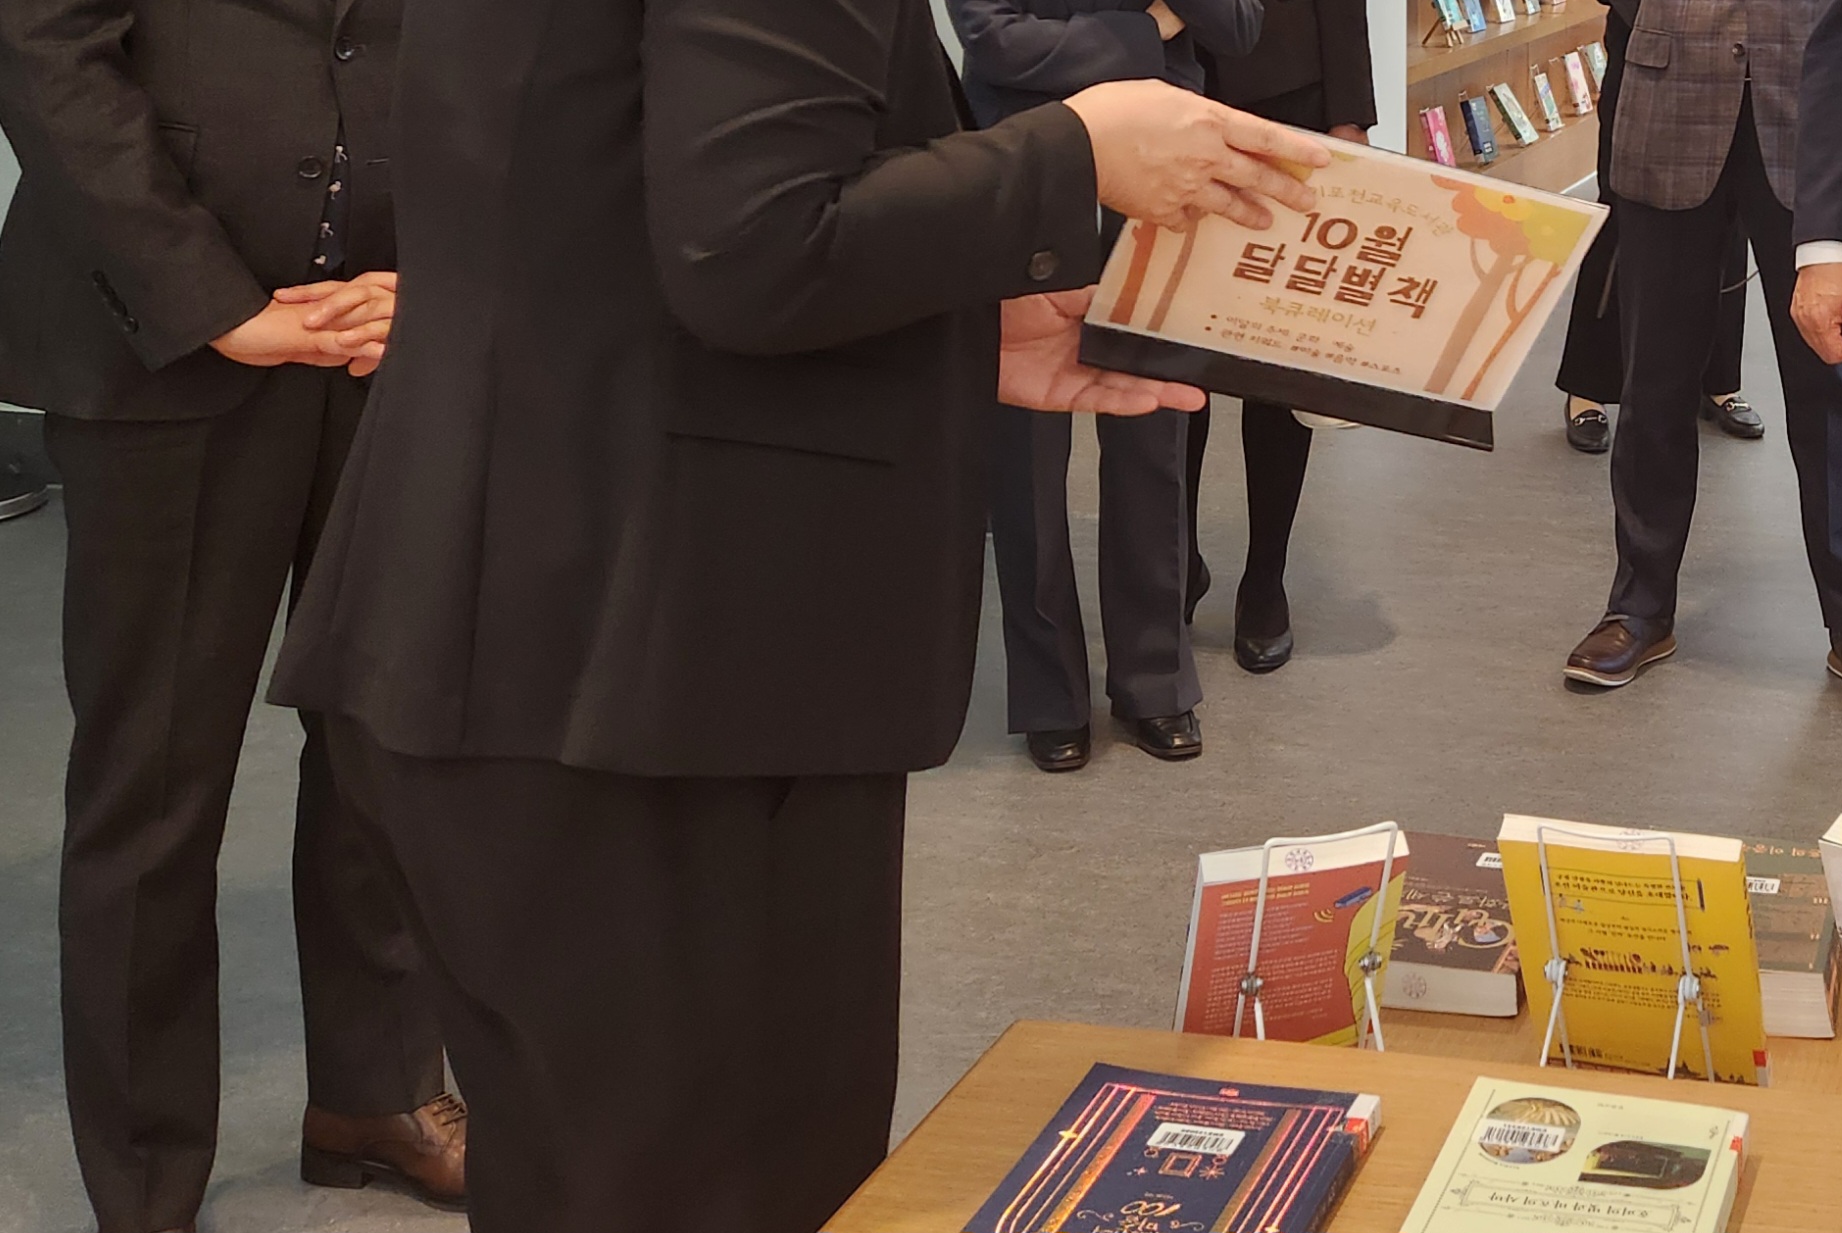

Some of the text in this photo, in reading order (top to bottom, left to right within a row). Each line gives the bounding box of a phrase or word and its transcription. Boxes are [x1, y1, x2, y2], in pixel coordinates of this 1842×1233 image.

[1312, 184, 1454, 238] 기포천교육도서관
[1300, 211, 1413, 268] 10월
[1259, 296, 1377, 336] 북큐레이션
